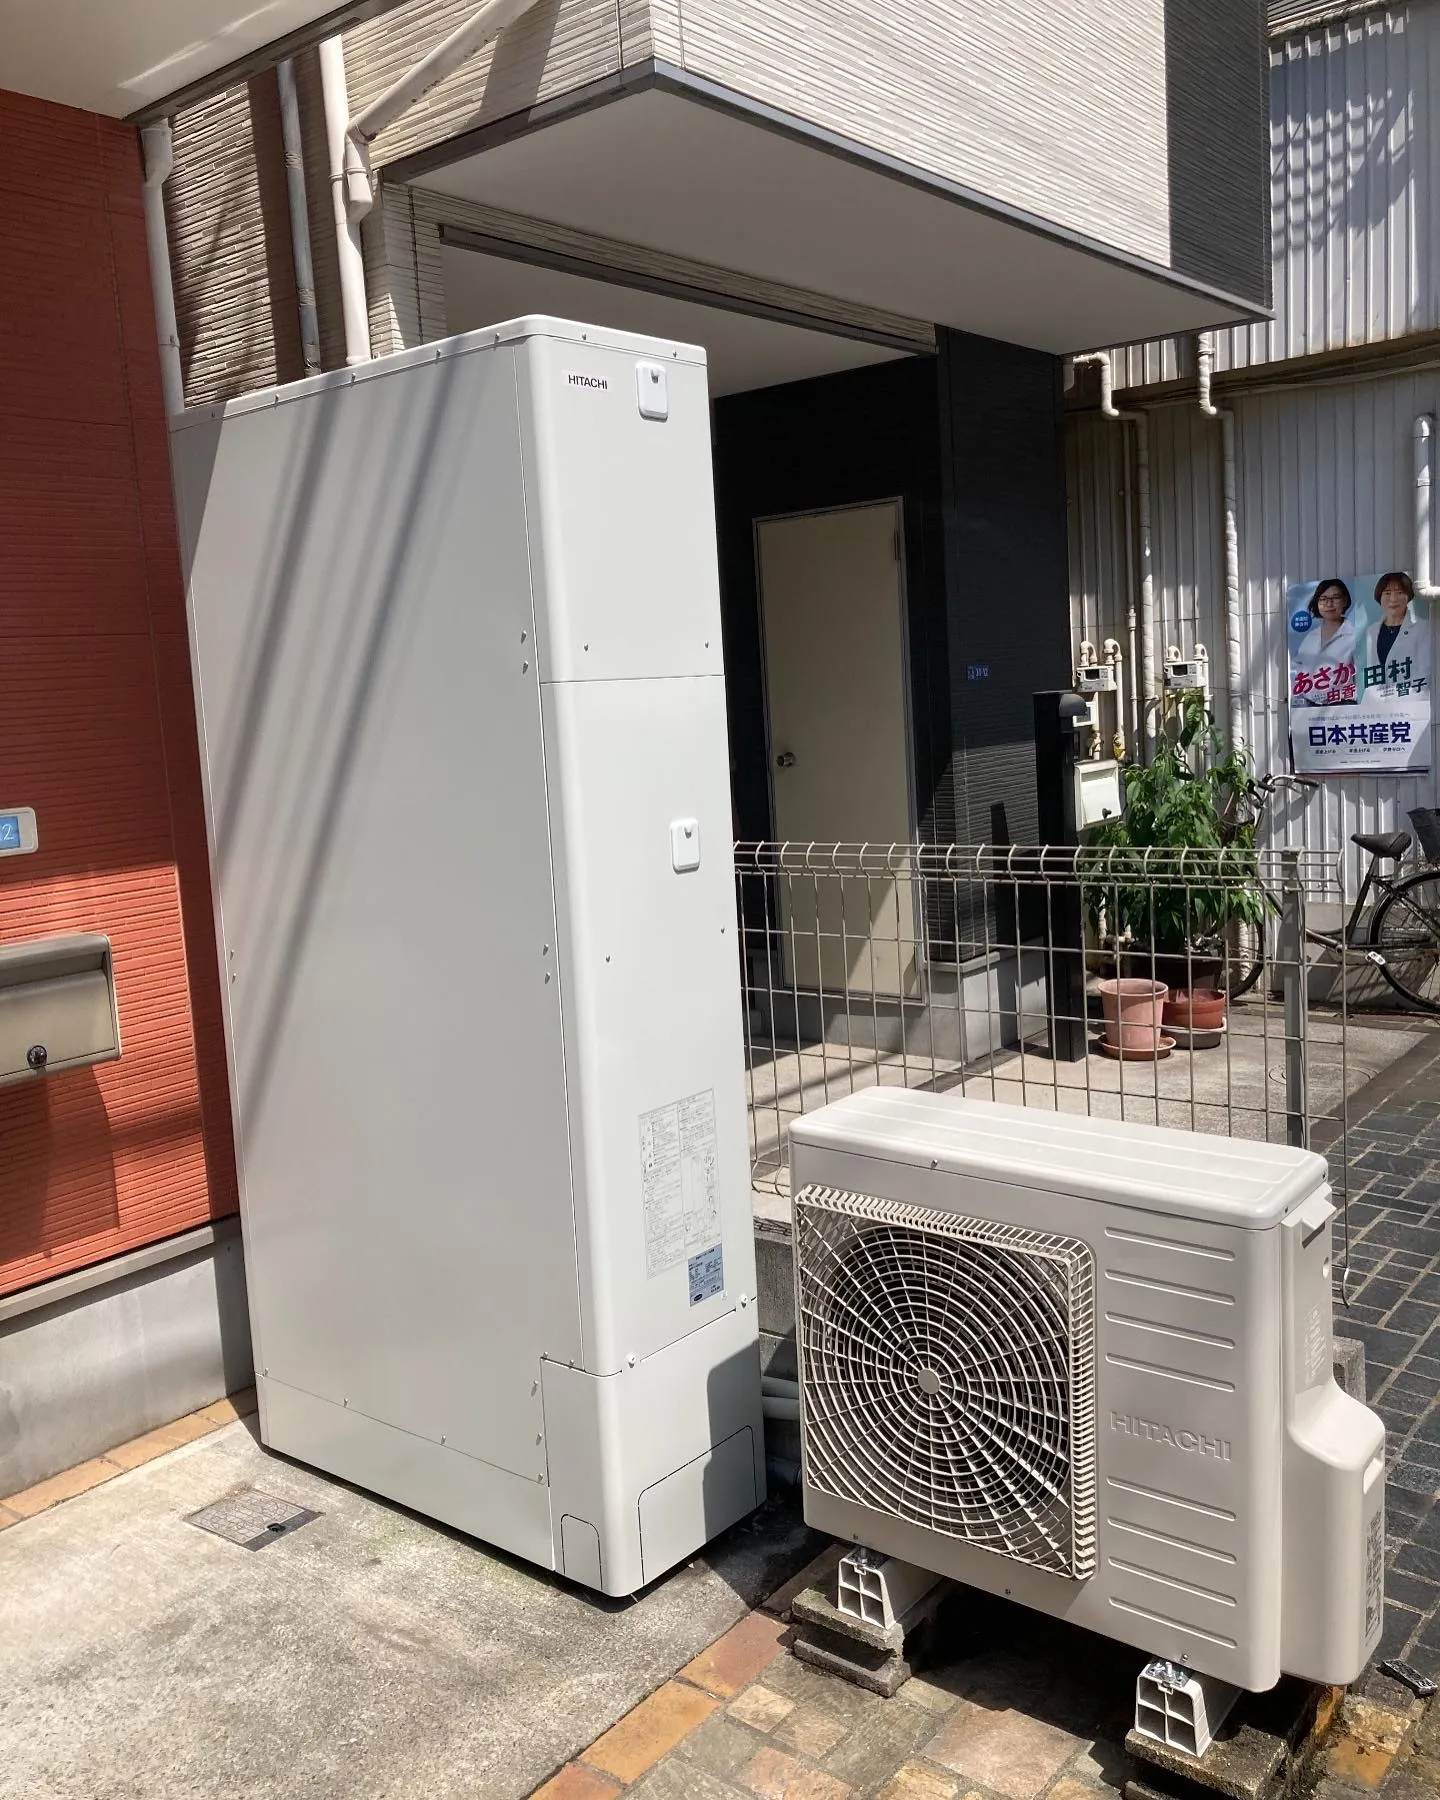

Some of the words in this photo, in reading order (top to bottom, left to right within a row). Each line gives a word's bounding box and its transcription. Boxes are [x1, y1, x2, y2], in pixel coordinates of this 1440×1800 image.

[568, 374, 608, 390] HITACHI
[1292, 662, 1356, 696] あさか
[1363, 656, 1413, 689] 田村
[1327, 684, 1356, 703] 由香
[1395, 677, 1428, 698] 智子
[1308, 721, 1412, 747] 日本共産党
[1109, 1411, 1233, 1462] HITACHI
